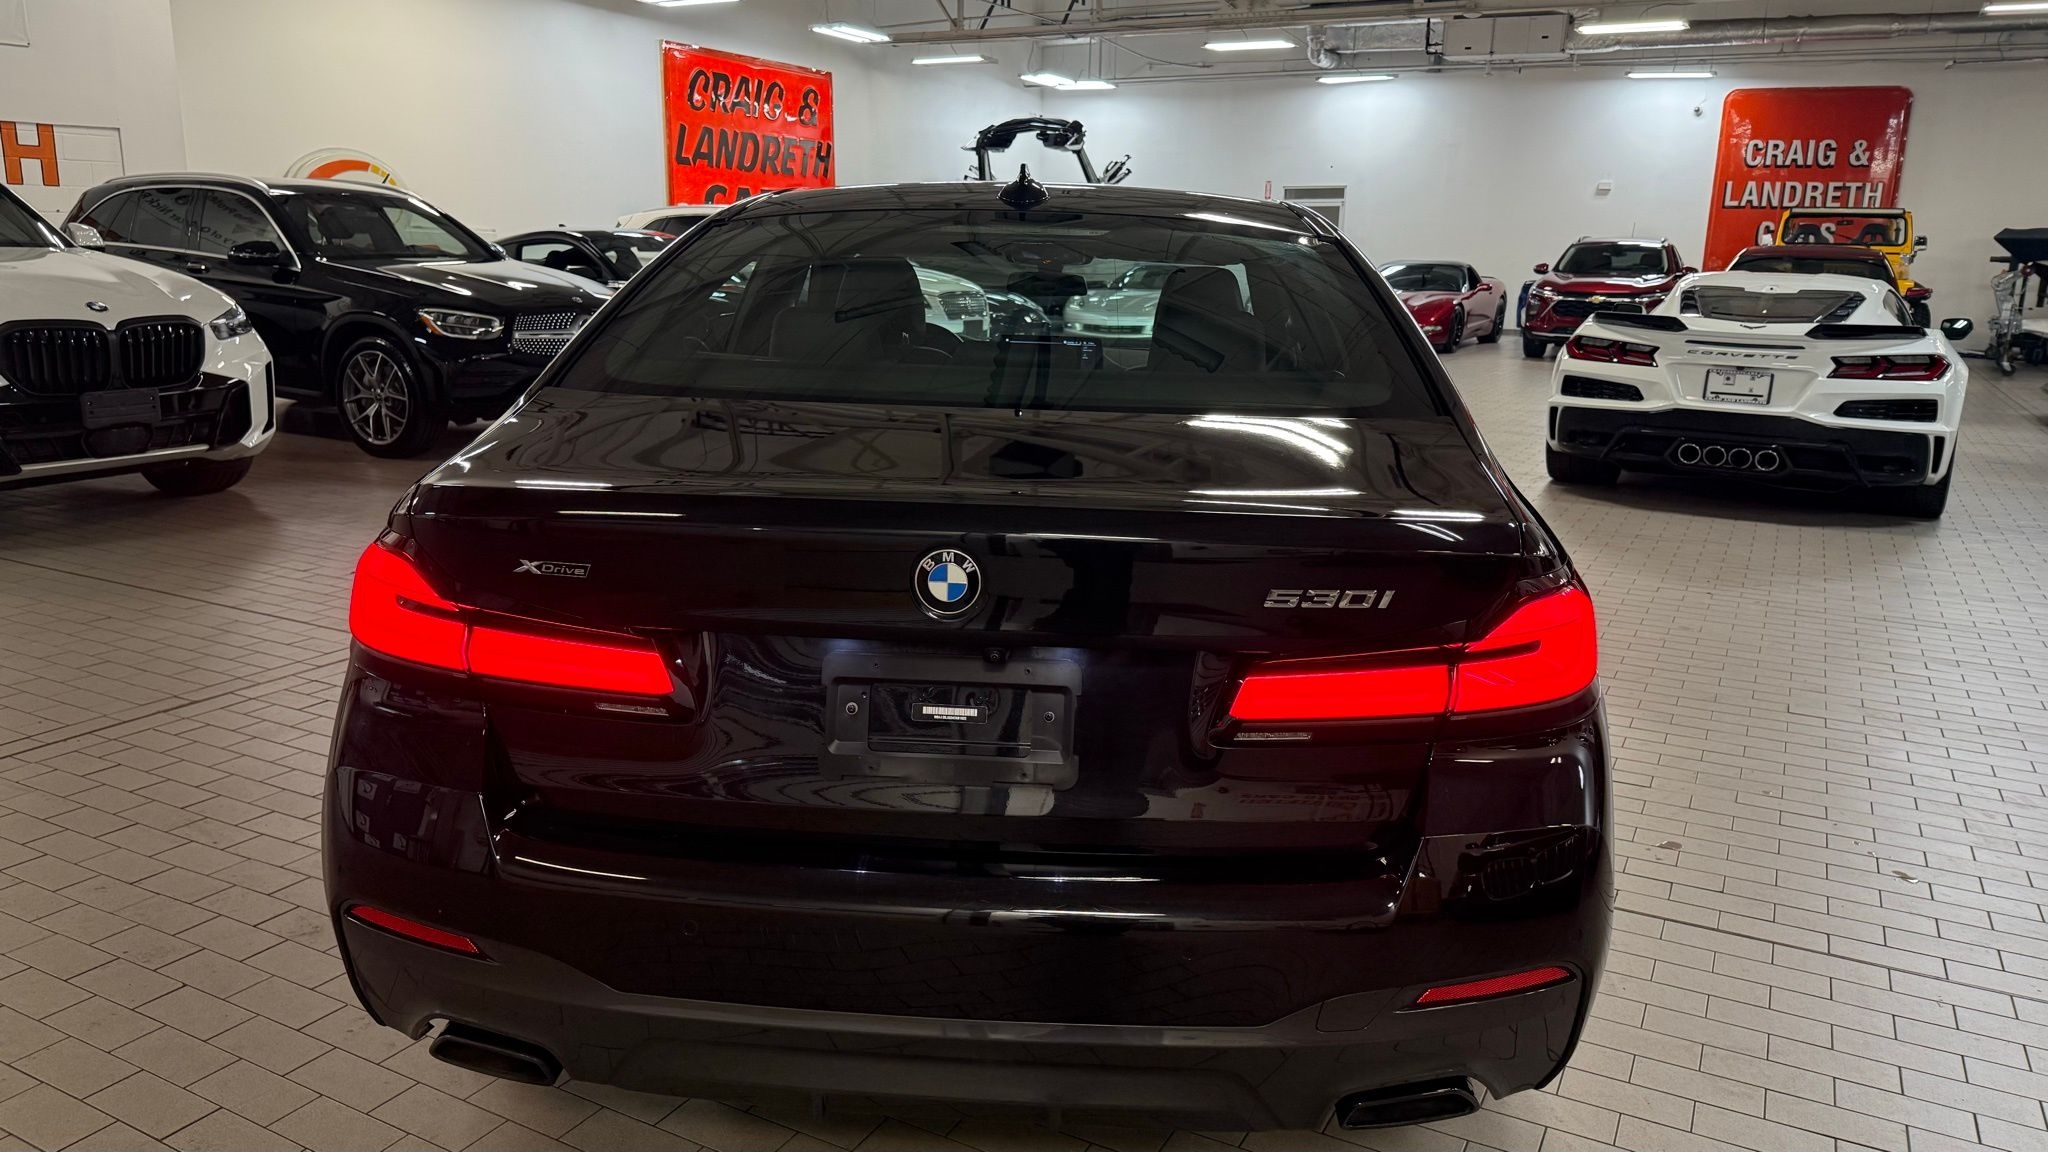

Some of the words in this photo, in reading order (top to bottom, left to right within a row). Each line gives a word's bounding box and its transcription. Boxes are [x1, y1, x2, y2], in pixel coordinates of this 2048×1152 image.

[687, 69, 784, 121] CRAIG
[798, 88, 819, 126] &
[675, 124, 832, 179] LANDRETH
[1745, 139, 1838, 168] CRAIG
[1849, 139, 1870, 168] &
[1723, 181, 1885, 209] LANDRETH
[1687, 349, 1800, 360] CORVETTE
[922, 551, 976, 574] BMW
